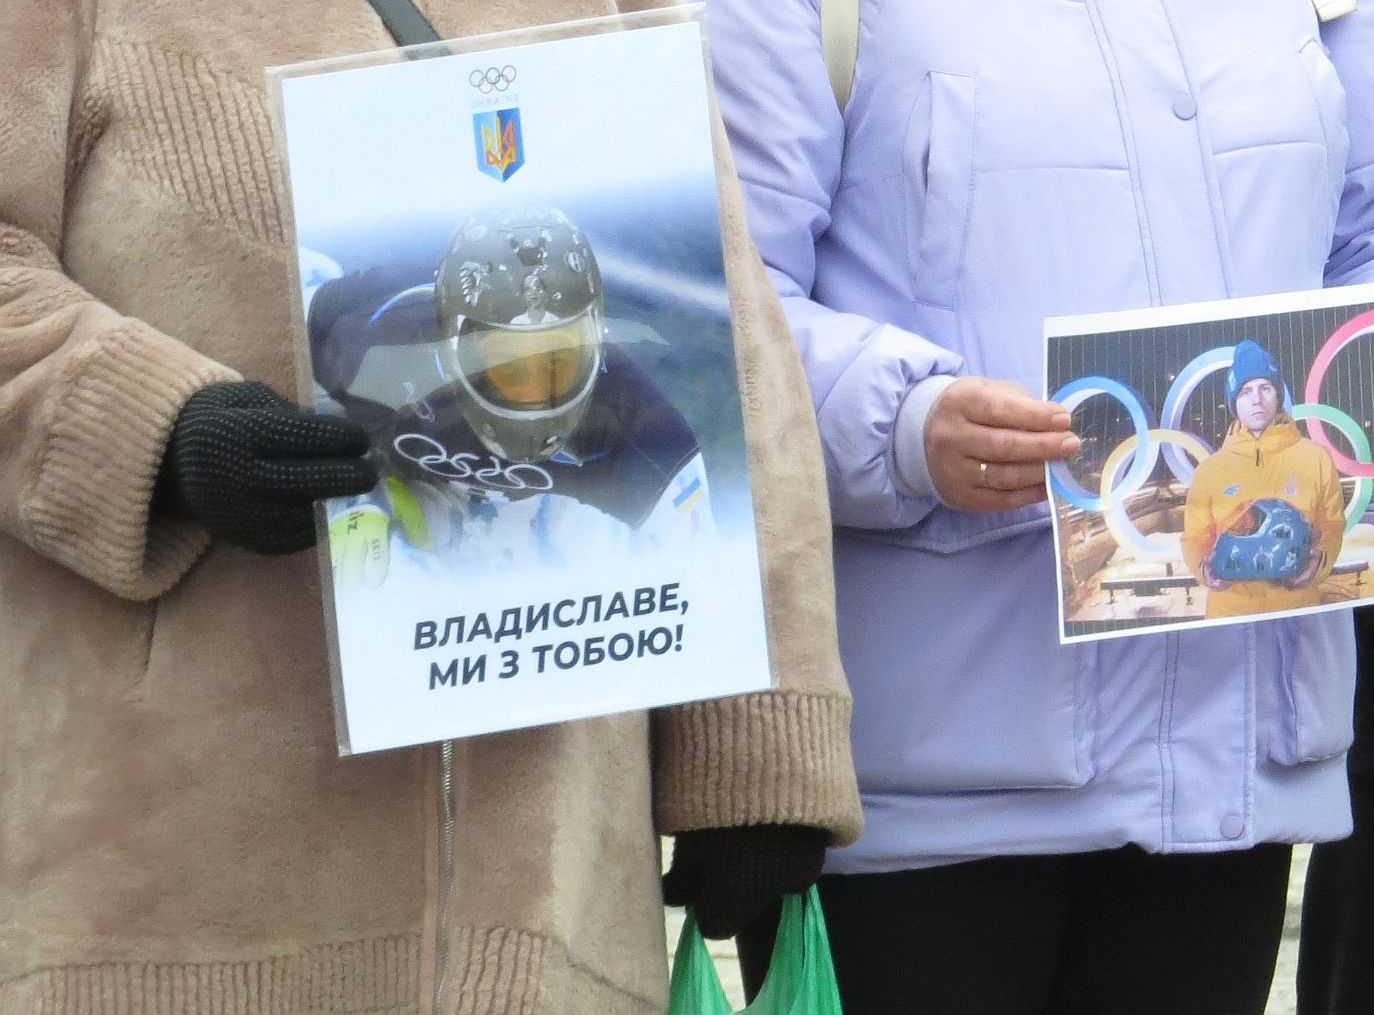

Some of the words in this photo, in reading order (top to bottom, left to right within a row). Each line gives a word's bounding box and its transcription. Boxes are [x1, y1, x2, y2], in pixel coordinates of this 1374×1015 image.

[413, 582, 690, 651] ВЛАДИСЛАВЕ,
[428, 654, 488, 690] МИ
[498, 650, 520, 679] З
[531, 624, 685, 674] ТОБОЮ!
